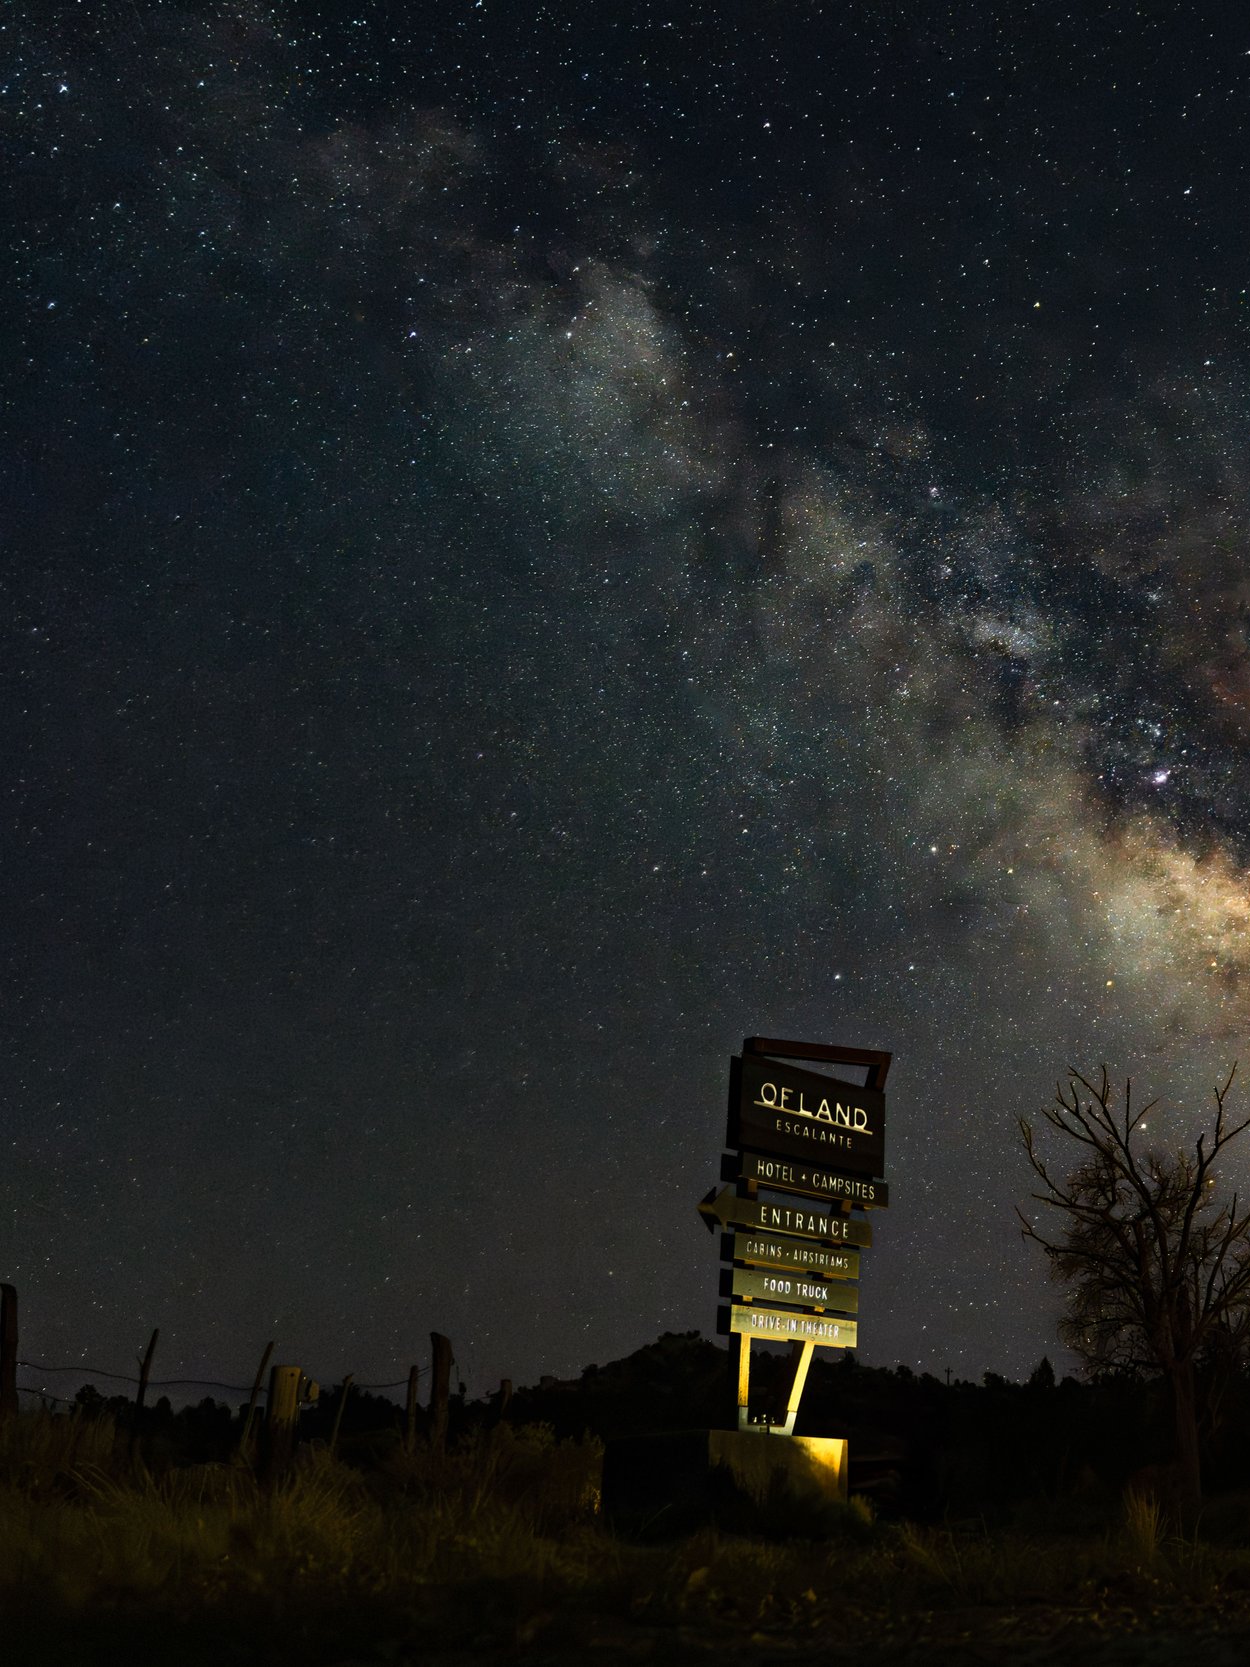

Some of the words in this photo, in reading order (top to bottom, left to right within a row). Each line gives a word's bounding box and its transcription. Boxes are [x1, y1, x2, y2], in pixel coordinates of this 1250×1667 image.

[776, 1119, 853, 1149] ESCALANTE
[757, 1160, 795, 1183] HOTEL
[812, 1173, 875, 1200] CAMPSITES
[760, 1206, 849, 1239] ENTRANCE
[746, 1241, 782, 1258] CABINS
[763, 1277, 791, 1294] FOOD
[796, 1283, 828, 1300] TRUCK
[751, 1314, 798, 1333] DRIVE-IN
[800, 1321, 839, 1339] THEATER
